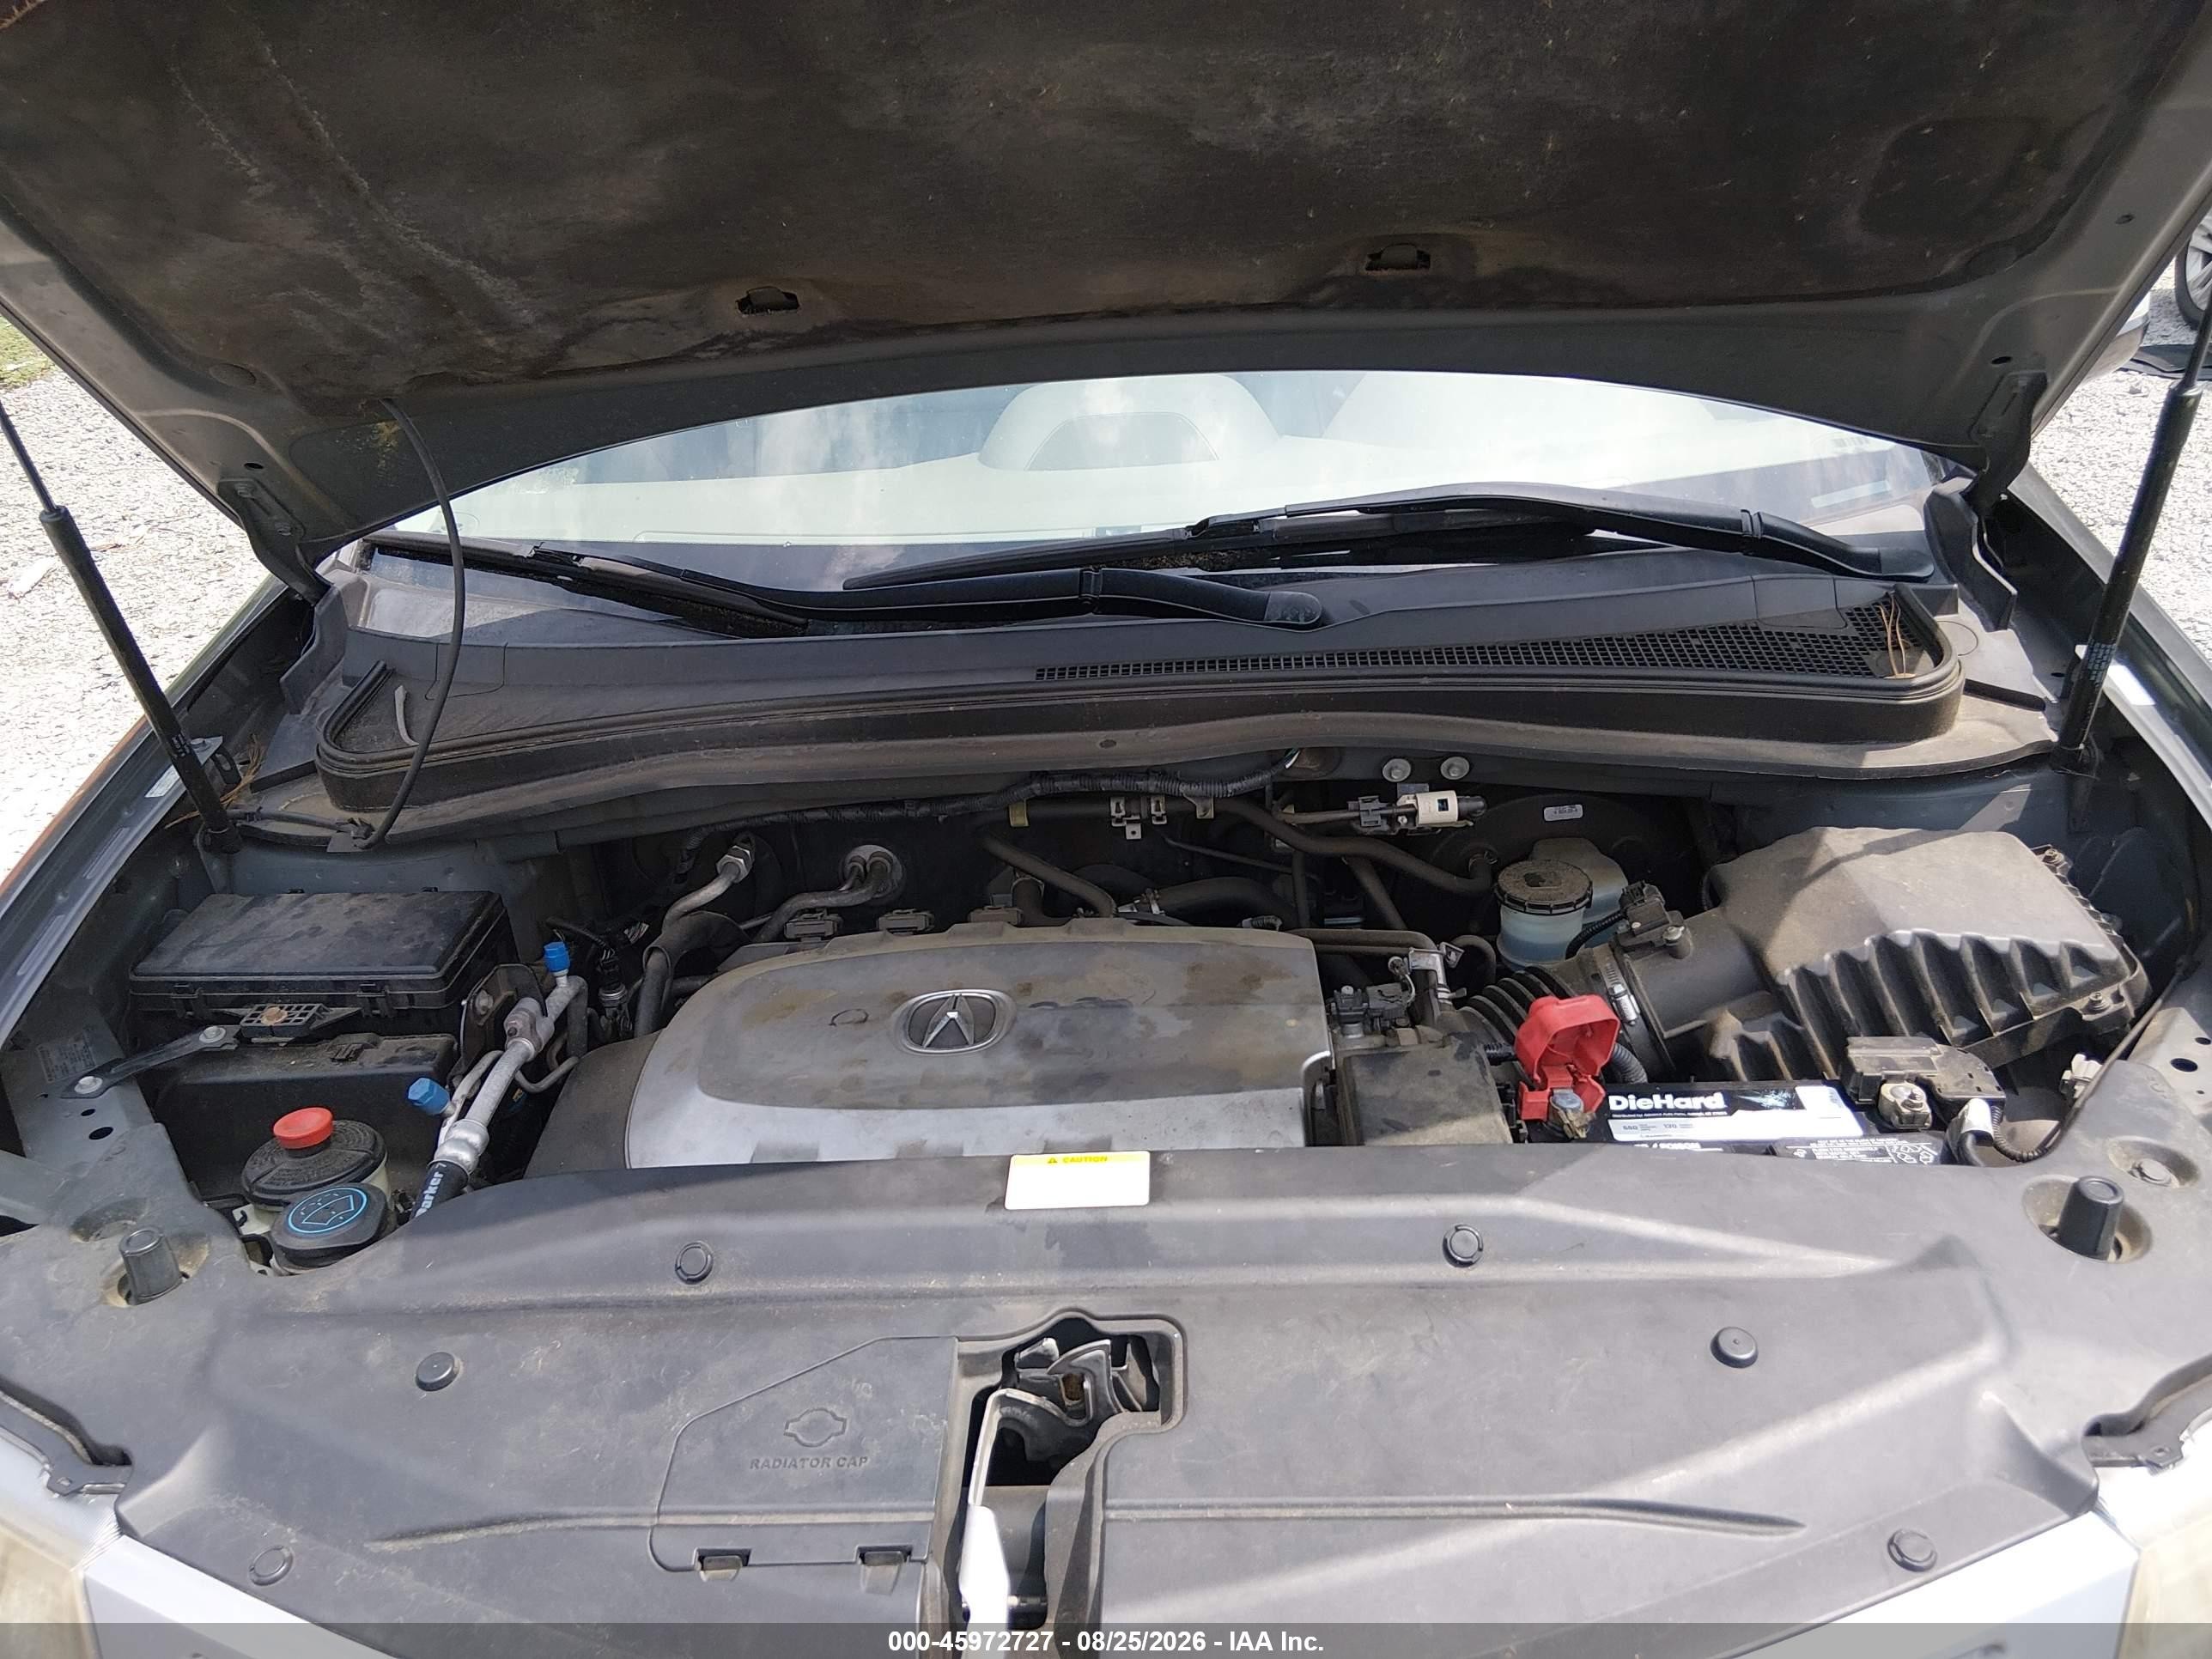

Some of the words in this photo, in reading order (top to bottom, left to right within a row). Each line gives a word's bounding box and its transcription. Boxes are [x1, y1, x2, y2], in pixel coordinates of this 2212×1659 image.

[1608, 1092, 1725, 1110] DieHard
[750, 1457, 831, 1469] RADIATOR
[836, 1456, 868, 1468] CAP
